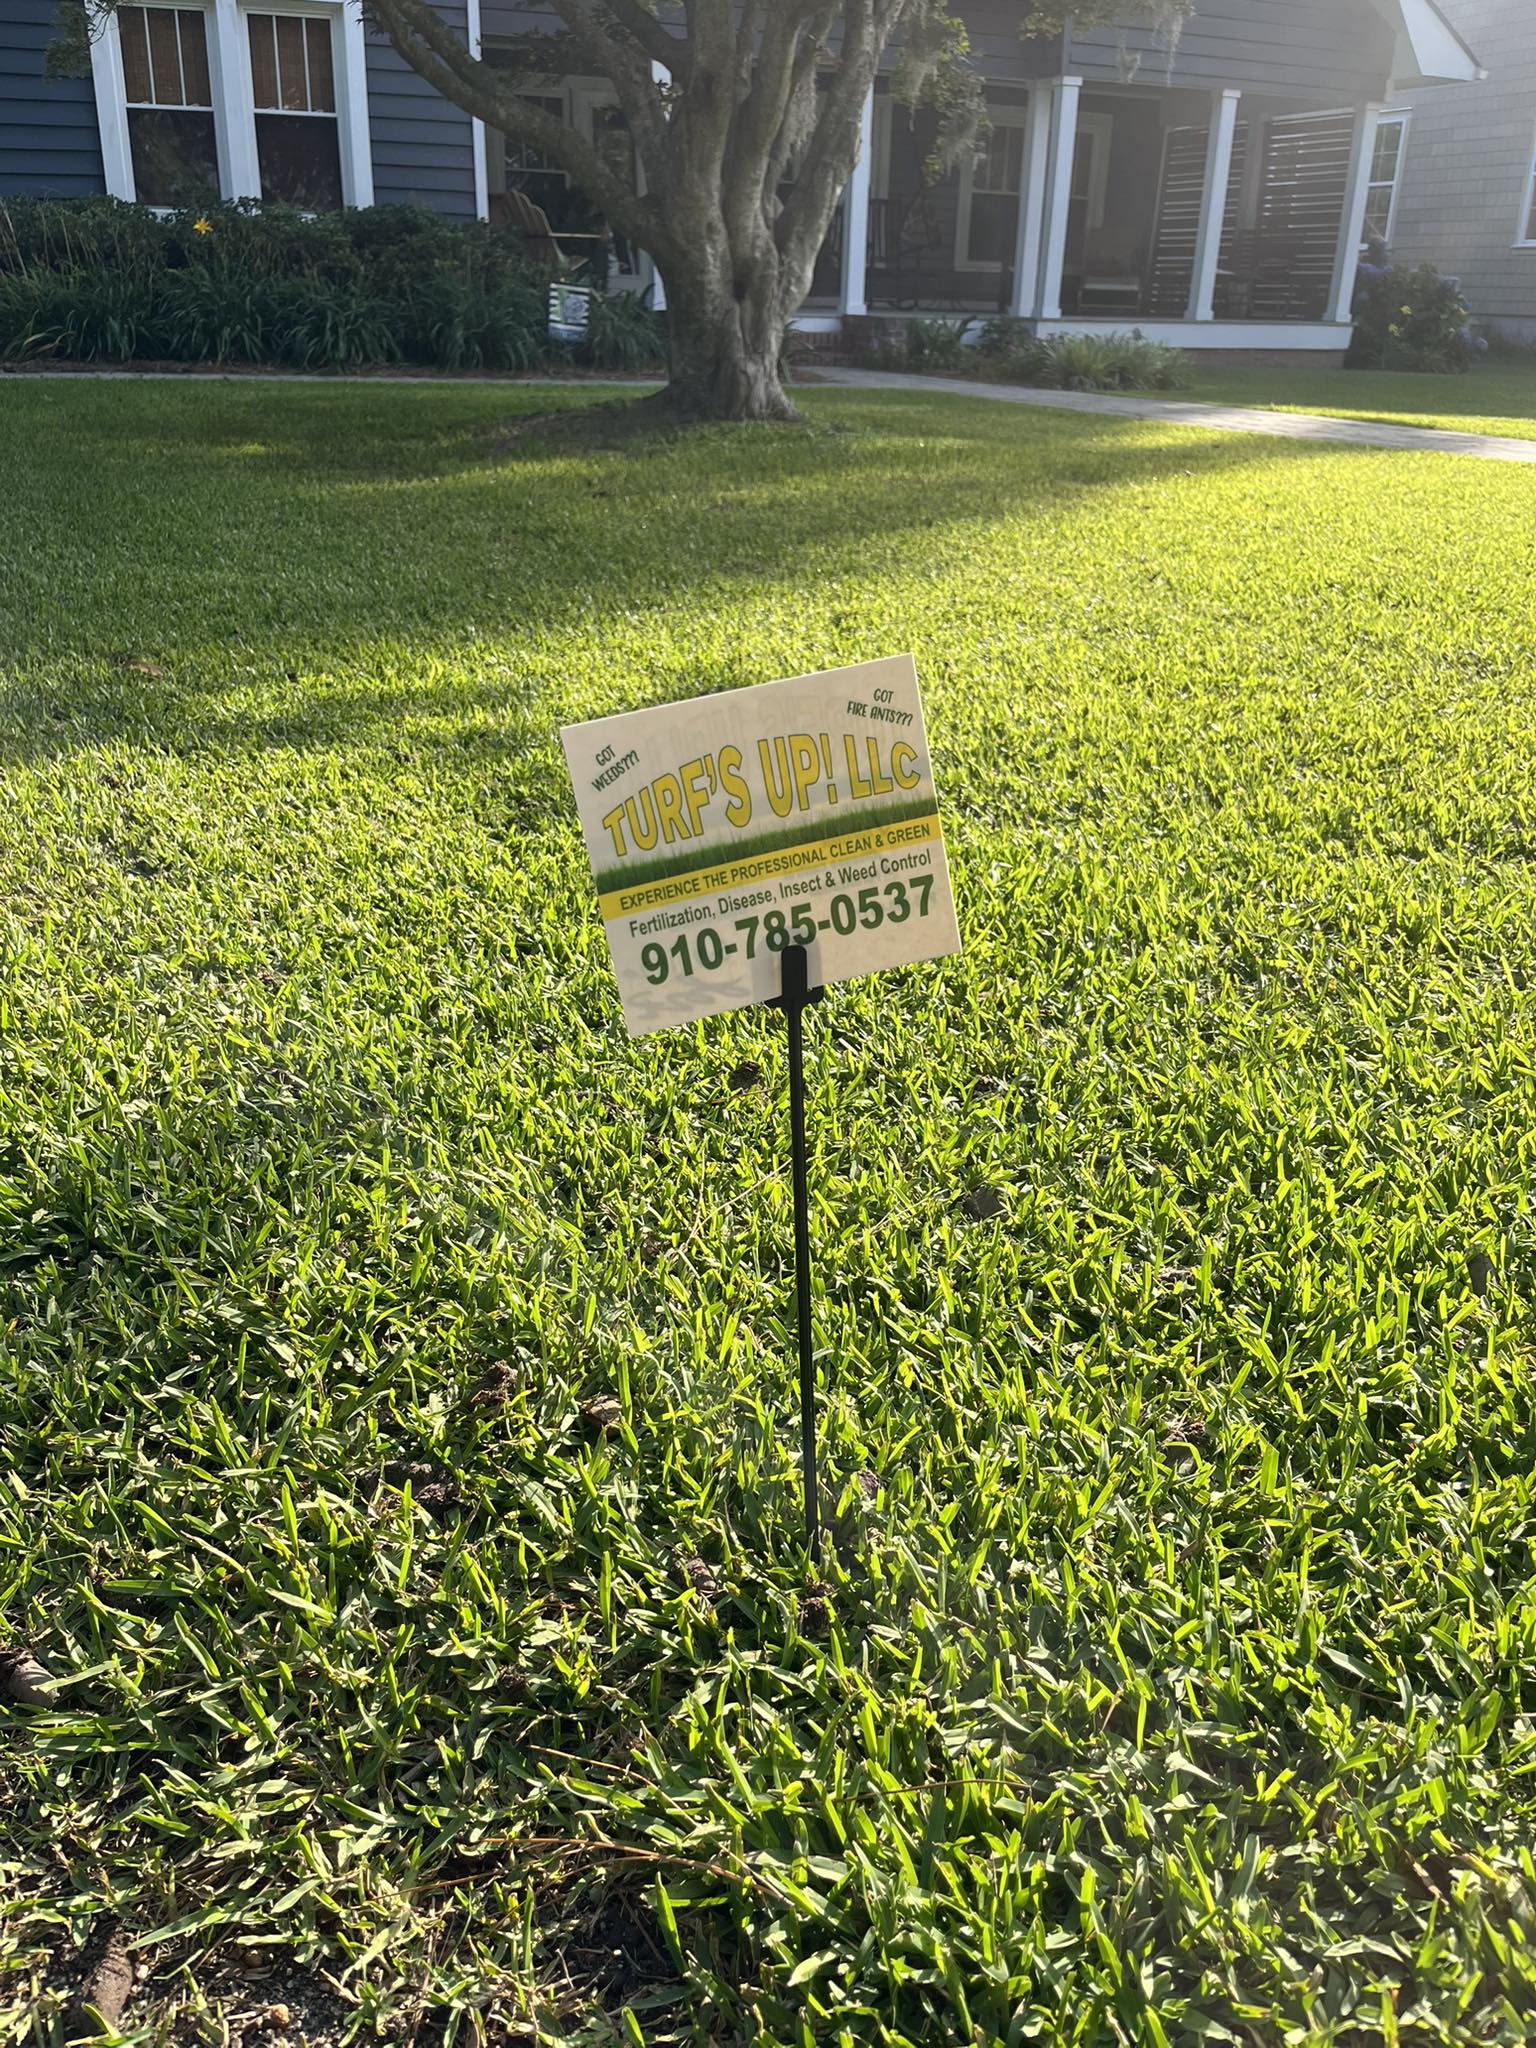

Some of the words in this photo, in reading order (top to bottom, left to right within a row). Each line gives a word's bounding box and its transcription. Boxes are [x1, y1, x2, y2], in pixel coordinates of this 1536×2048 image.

[846, 701, 868, 717] FIRE
[870, 706, 913, 726] ANTS???
[873, 688, 894, 704] GOT
[591, 750, 641, 792] WEEDS???
[595, 745, 617, 766] GOT
[602, 745, 752, 857] TURF'S
[757, 733, 838, 817] UP!
[843, 734, 921, 800] LLC
[619, 878, 701, 911] EXPERIENCE
[703, 871, 728, 889] THE
[731, 847, 827, 882] PROFESSIONAL
[829, 838, 872, 858] CLEAN
[875, 834, 884, 847] &
[887, 823, 930, 842] GREEN
[629, 905, 716, 938] Fertilization,
[718, 888, 777, 915] Disease,
[779, 877, 822, 899] Insect
[825, 872, 836, 888] &
[837, 861, 877, 884] Weed
[880, 848, 931, 875] Control
[641, 874, 934, 985] 910-785-0537
